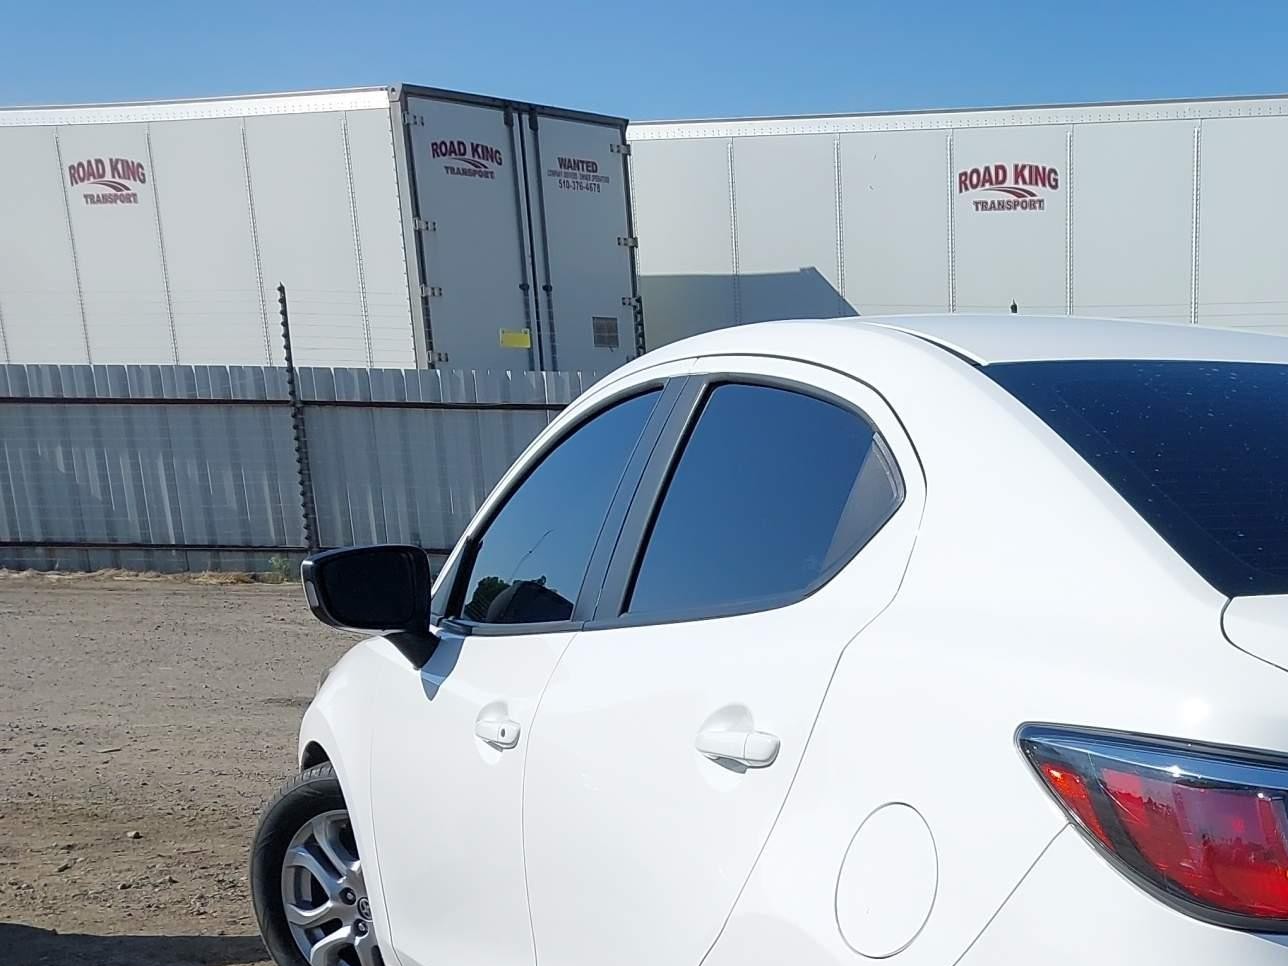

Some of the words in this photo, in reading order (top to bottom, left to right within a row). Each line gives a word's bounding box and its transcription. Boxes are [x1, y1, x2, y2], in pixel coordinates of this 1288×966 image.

[431, 140, 467, 159] ROAD
[470, 142, 503, 166] KING
[68, 158, 106, 187] ROAD
[109, 158, 147, 184] KING
[443, 166, 495, 180] TRANSPORT
[557, 156, 598, 173] WANTED
[958, 164, 1007, 194] ROAD
[1013, 163, 1059, 190] KING
[83, 192, 139, 205] TRANSPORT
[973, 199, 1045, 212] TRANSPORT
